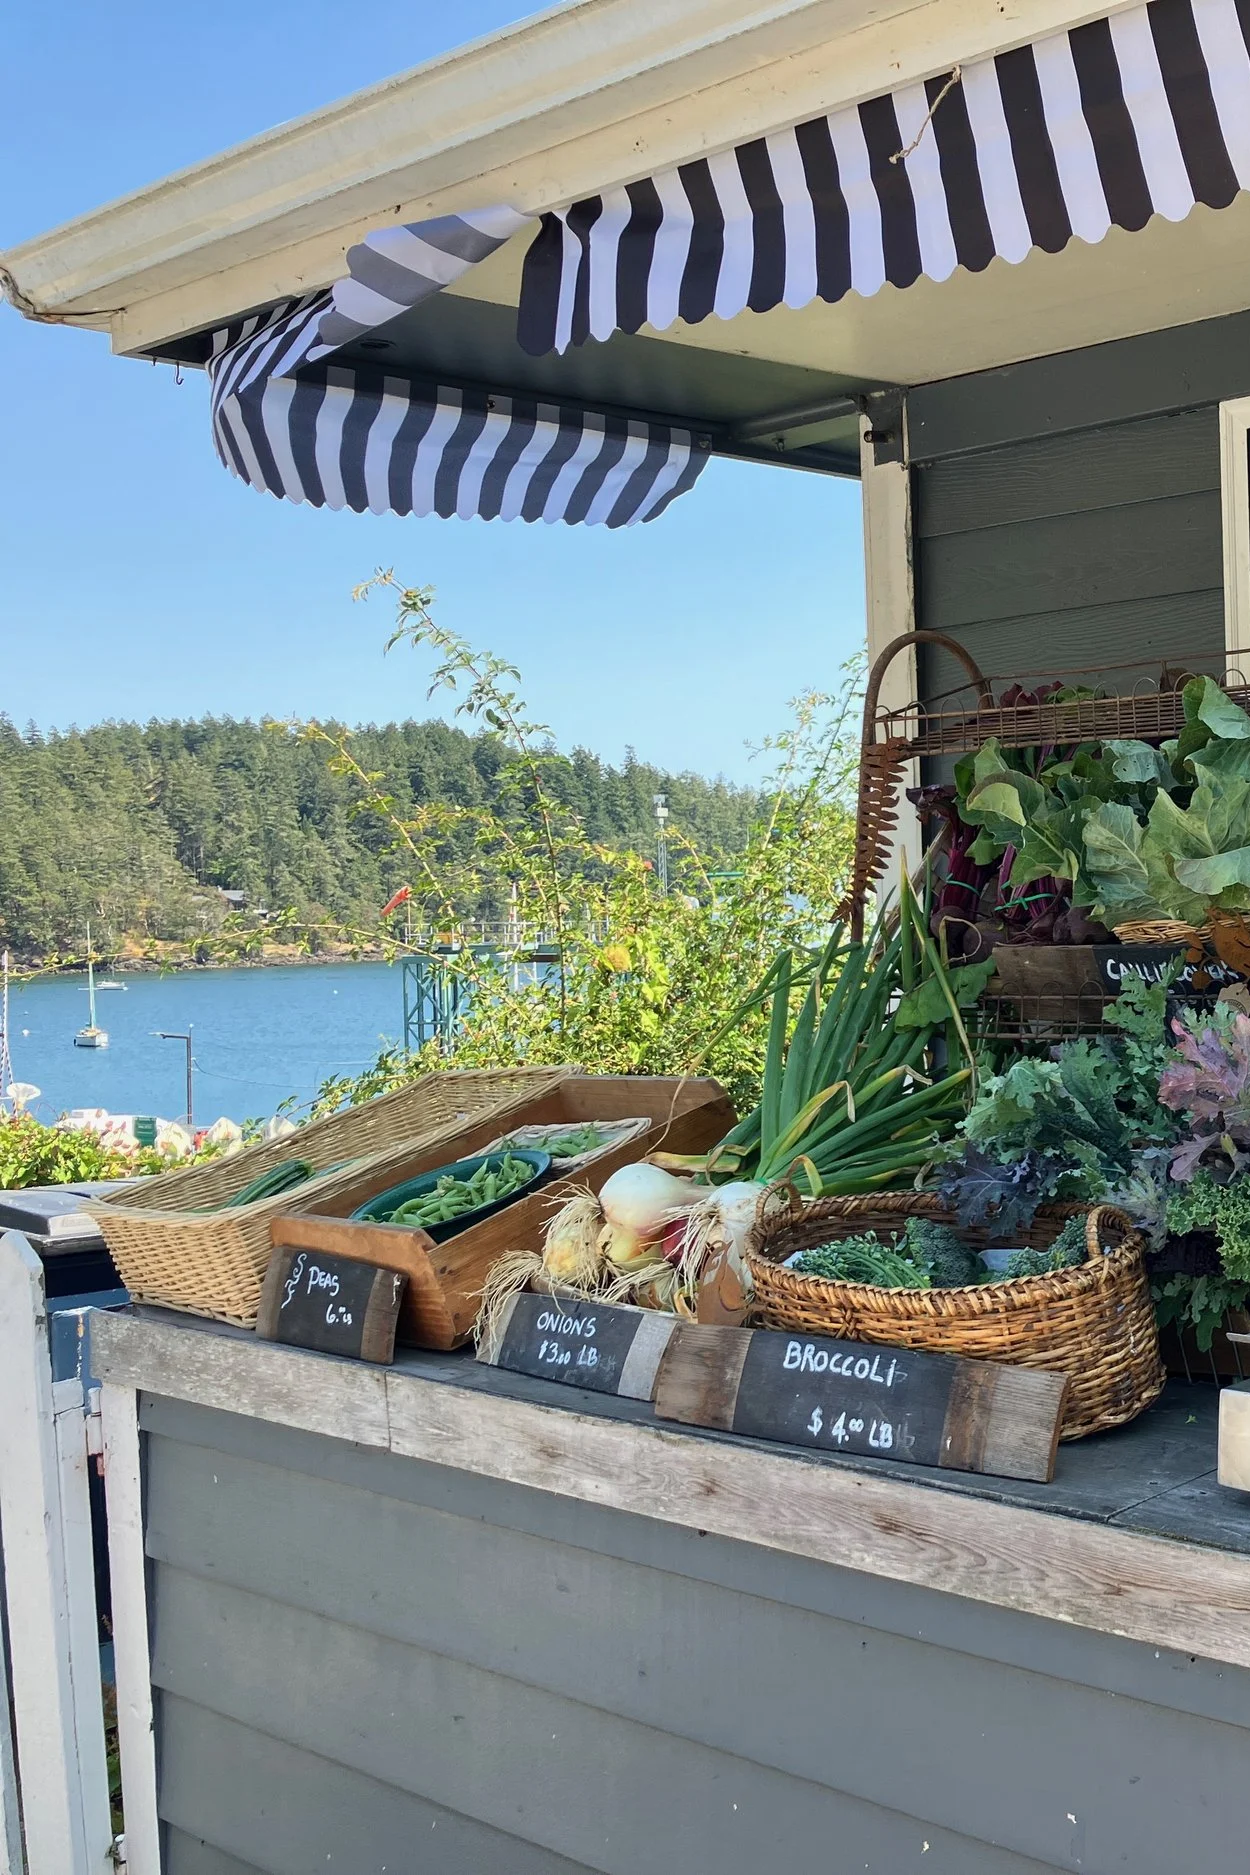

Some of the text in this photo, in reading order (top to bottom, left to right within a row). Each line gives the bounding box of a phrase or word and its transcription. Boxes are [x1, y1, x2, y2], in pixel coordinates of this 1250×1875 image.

[307, 1265, 340, 1297] PEAS
[536, 1311, 597, 1338] ONIONS
[576, 1344, 598, 1367] LB
[783, 1340, 898, 1387] BROCCOLI
[868, 1419, 893, 1449] LB
